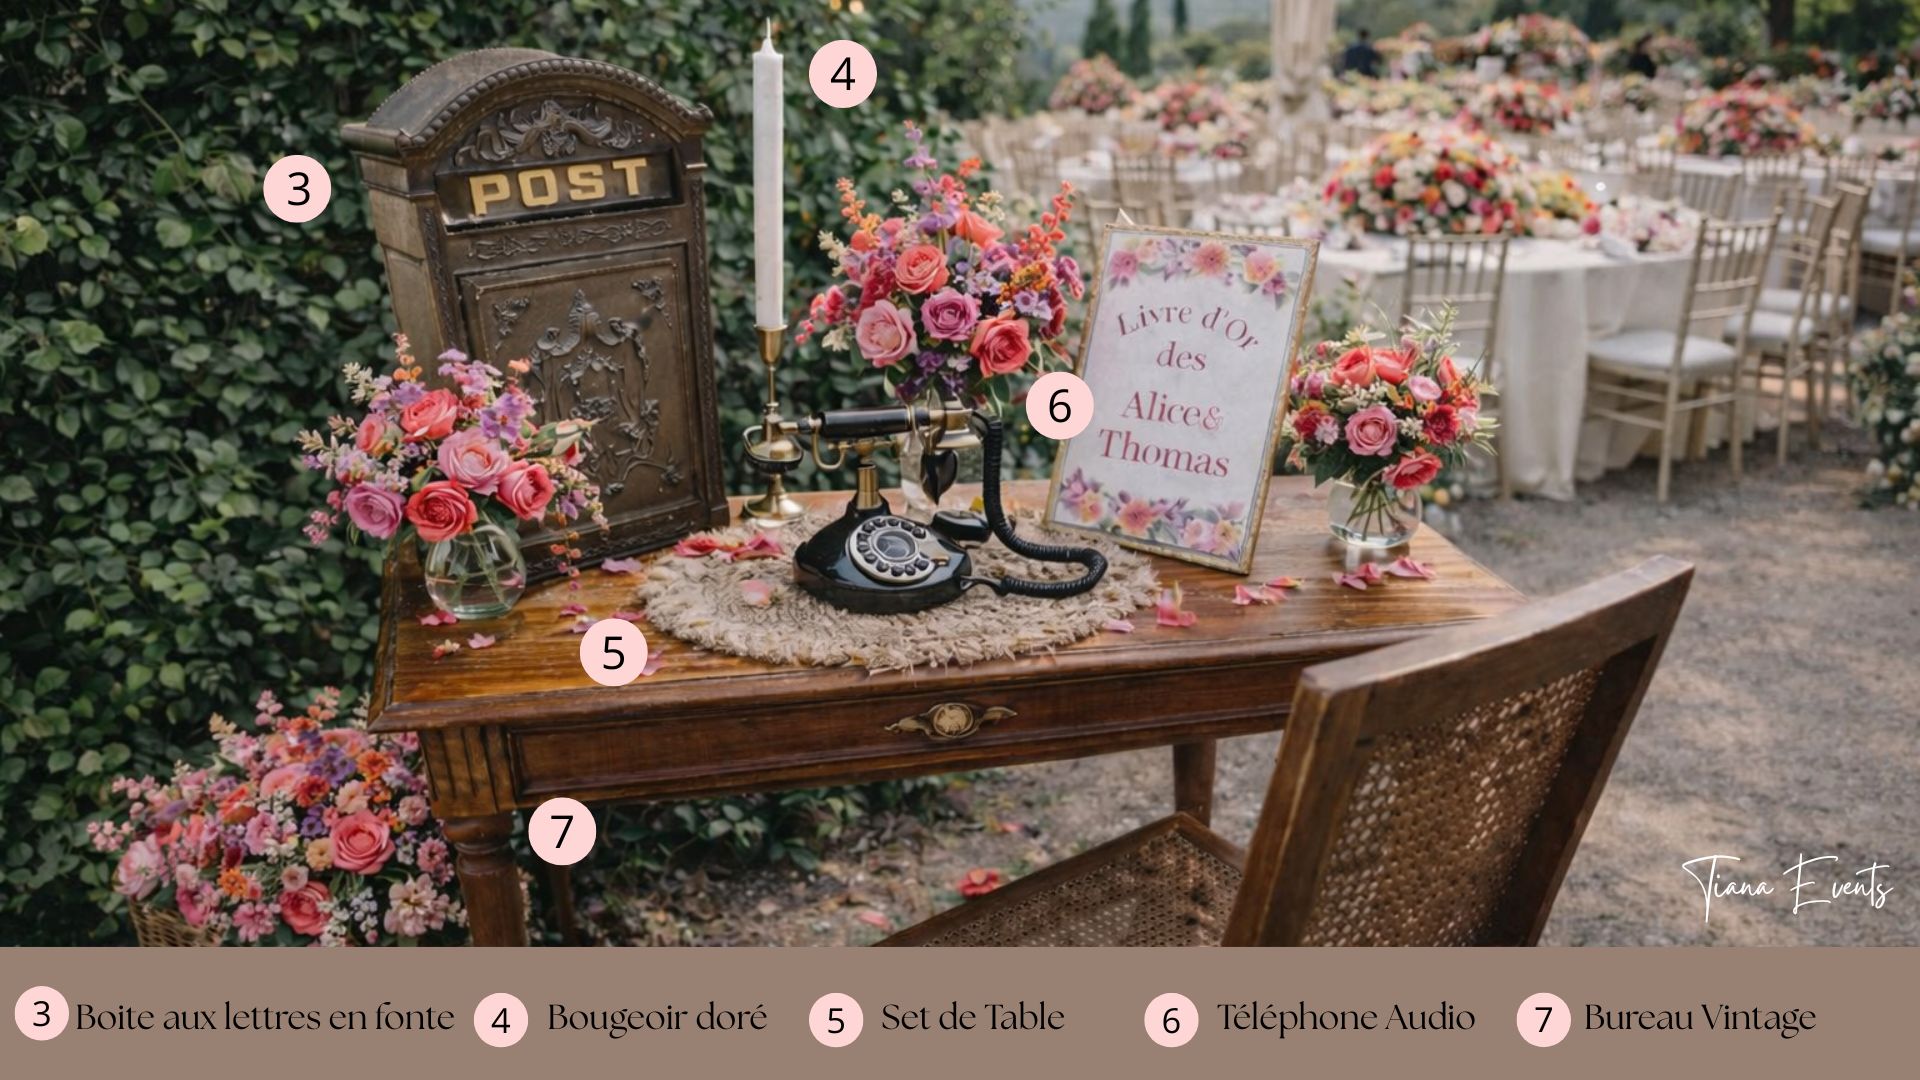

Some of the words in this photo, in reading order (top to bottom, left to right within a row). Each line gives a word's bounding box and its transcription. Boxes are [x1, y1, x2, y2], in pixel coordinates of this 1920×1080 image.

[469, 157, 647, 216] POST
[1117, 304, 1192, 336] Livre
[1201, 306, 1258, 350] d'Or
[1156, 341, 1206, 371] des
[1099, 428, 1230, 478] Thomas
